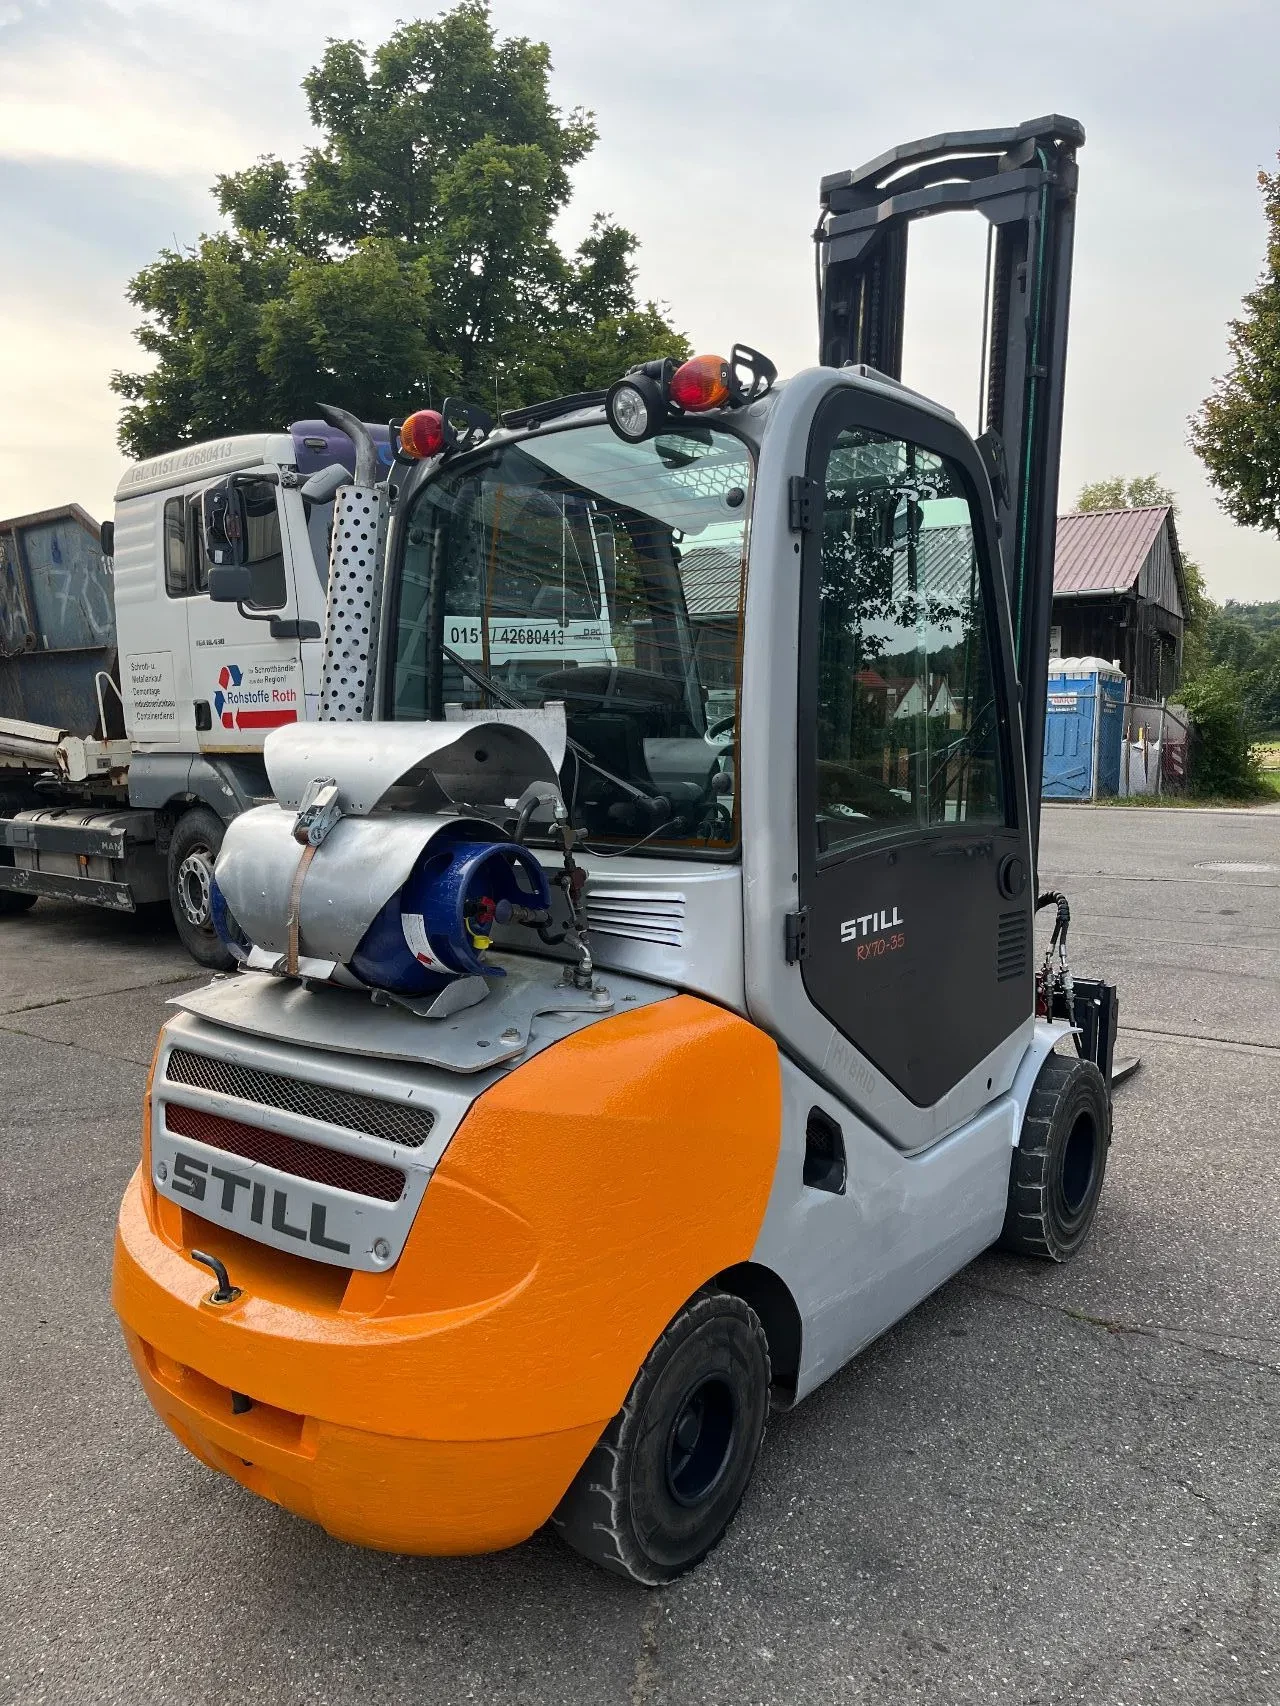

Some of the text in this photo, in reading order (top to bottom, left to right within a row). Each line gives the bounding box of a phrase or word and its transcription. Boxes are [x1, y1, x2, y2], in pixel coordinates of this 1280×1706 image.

[152, 457, 174, 476] 0151
[182, 442, 232, 469] 42680413
[492, 628, 497, 644] /
[501, 628, 564, 645] 42680413
[227, 689, 297, 704] Rohstoffe Roth
[840, 906, 904, 943] STILL
[171, 1152, 350, 1255] STILL
